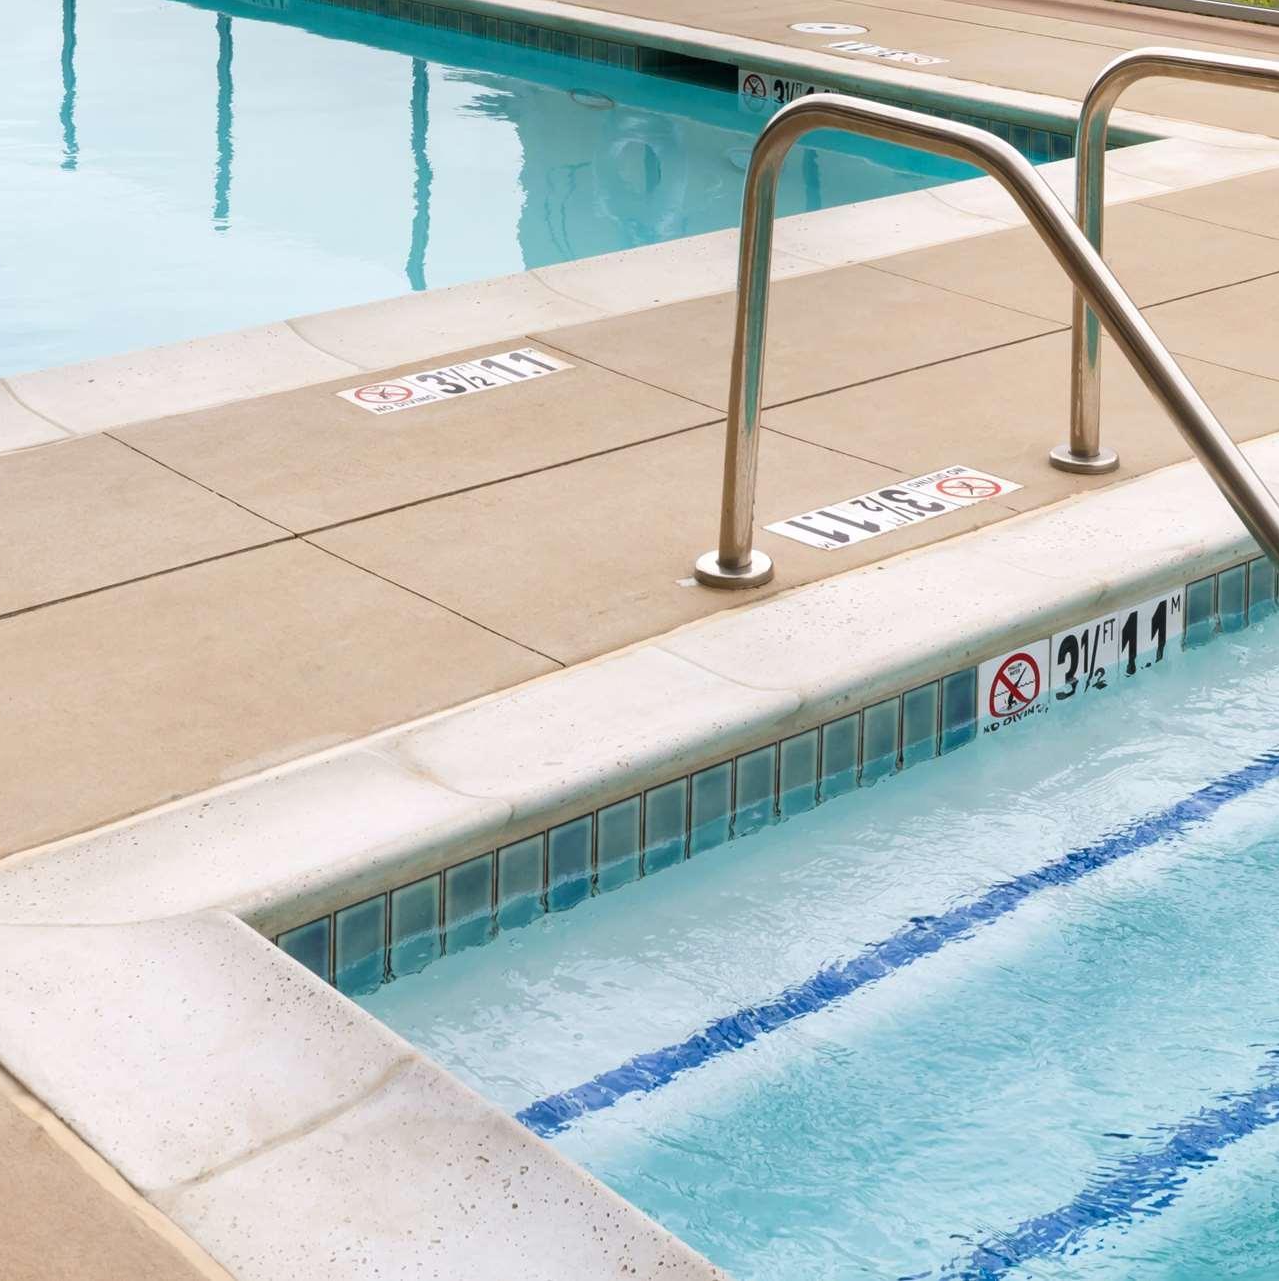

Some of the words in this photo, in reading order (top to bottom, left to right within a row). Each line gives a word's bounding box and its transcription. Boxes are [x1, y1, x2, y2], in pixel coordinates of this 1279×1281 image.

[480, 352, 558, 379] 1.1
[373, 403, 395, 413] NO
[394, 394, 438, 408] DIVING
[906, 473, 950, 489] DIVING
[945, 467, 969, 476] NO
[784, 510, 882, 544] 1.1
[1102, 618, 1116, 644] FT
[1121, 599, 1168, 677] 1.1
[1170, 594, 1181, 615] M
[983, 721, 1001, 734] NO
